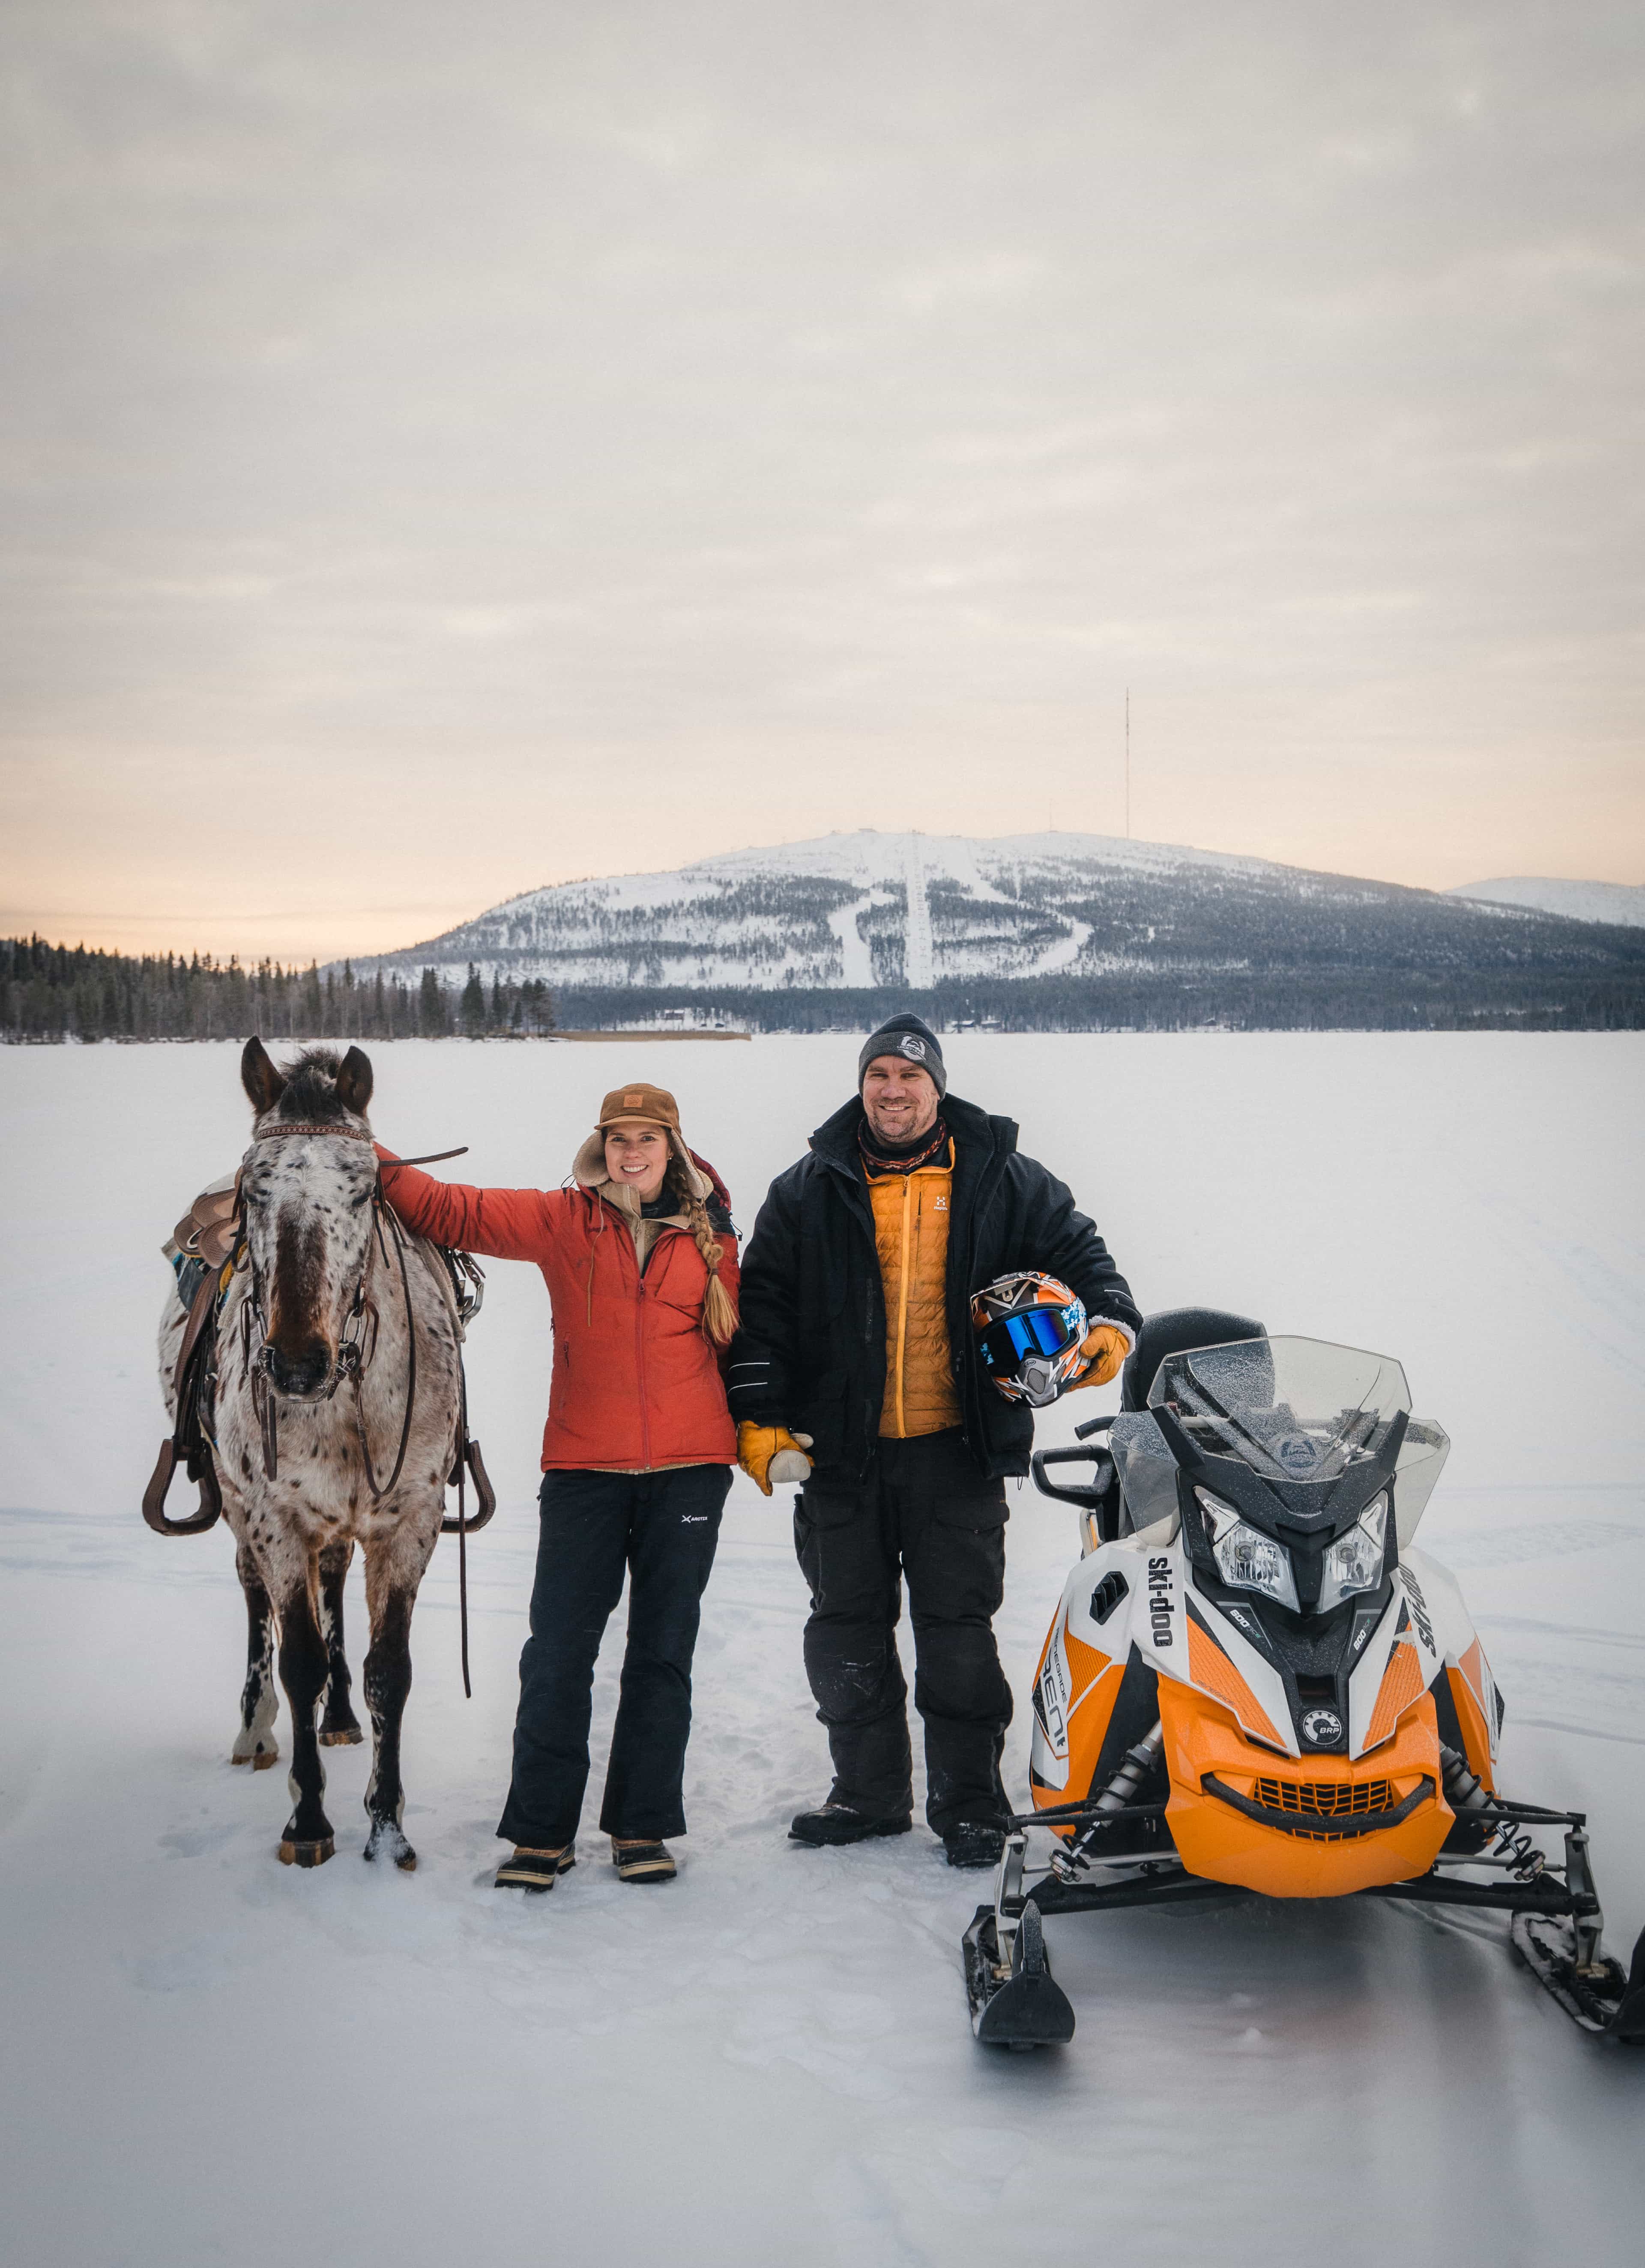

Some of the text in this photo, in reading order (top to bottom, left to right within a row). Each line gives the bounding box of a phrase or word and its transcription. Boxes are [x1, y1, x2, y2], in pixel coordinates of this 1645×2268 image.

[1149, 1557, 1175, 1647] ski-doo
[1230, 1609, 1250, 1628] 600
[1353, 1629, 1367, 1651] 600
